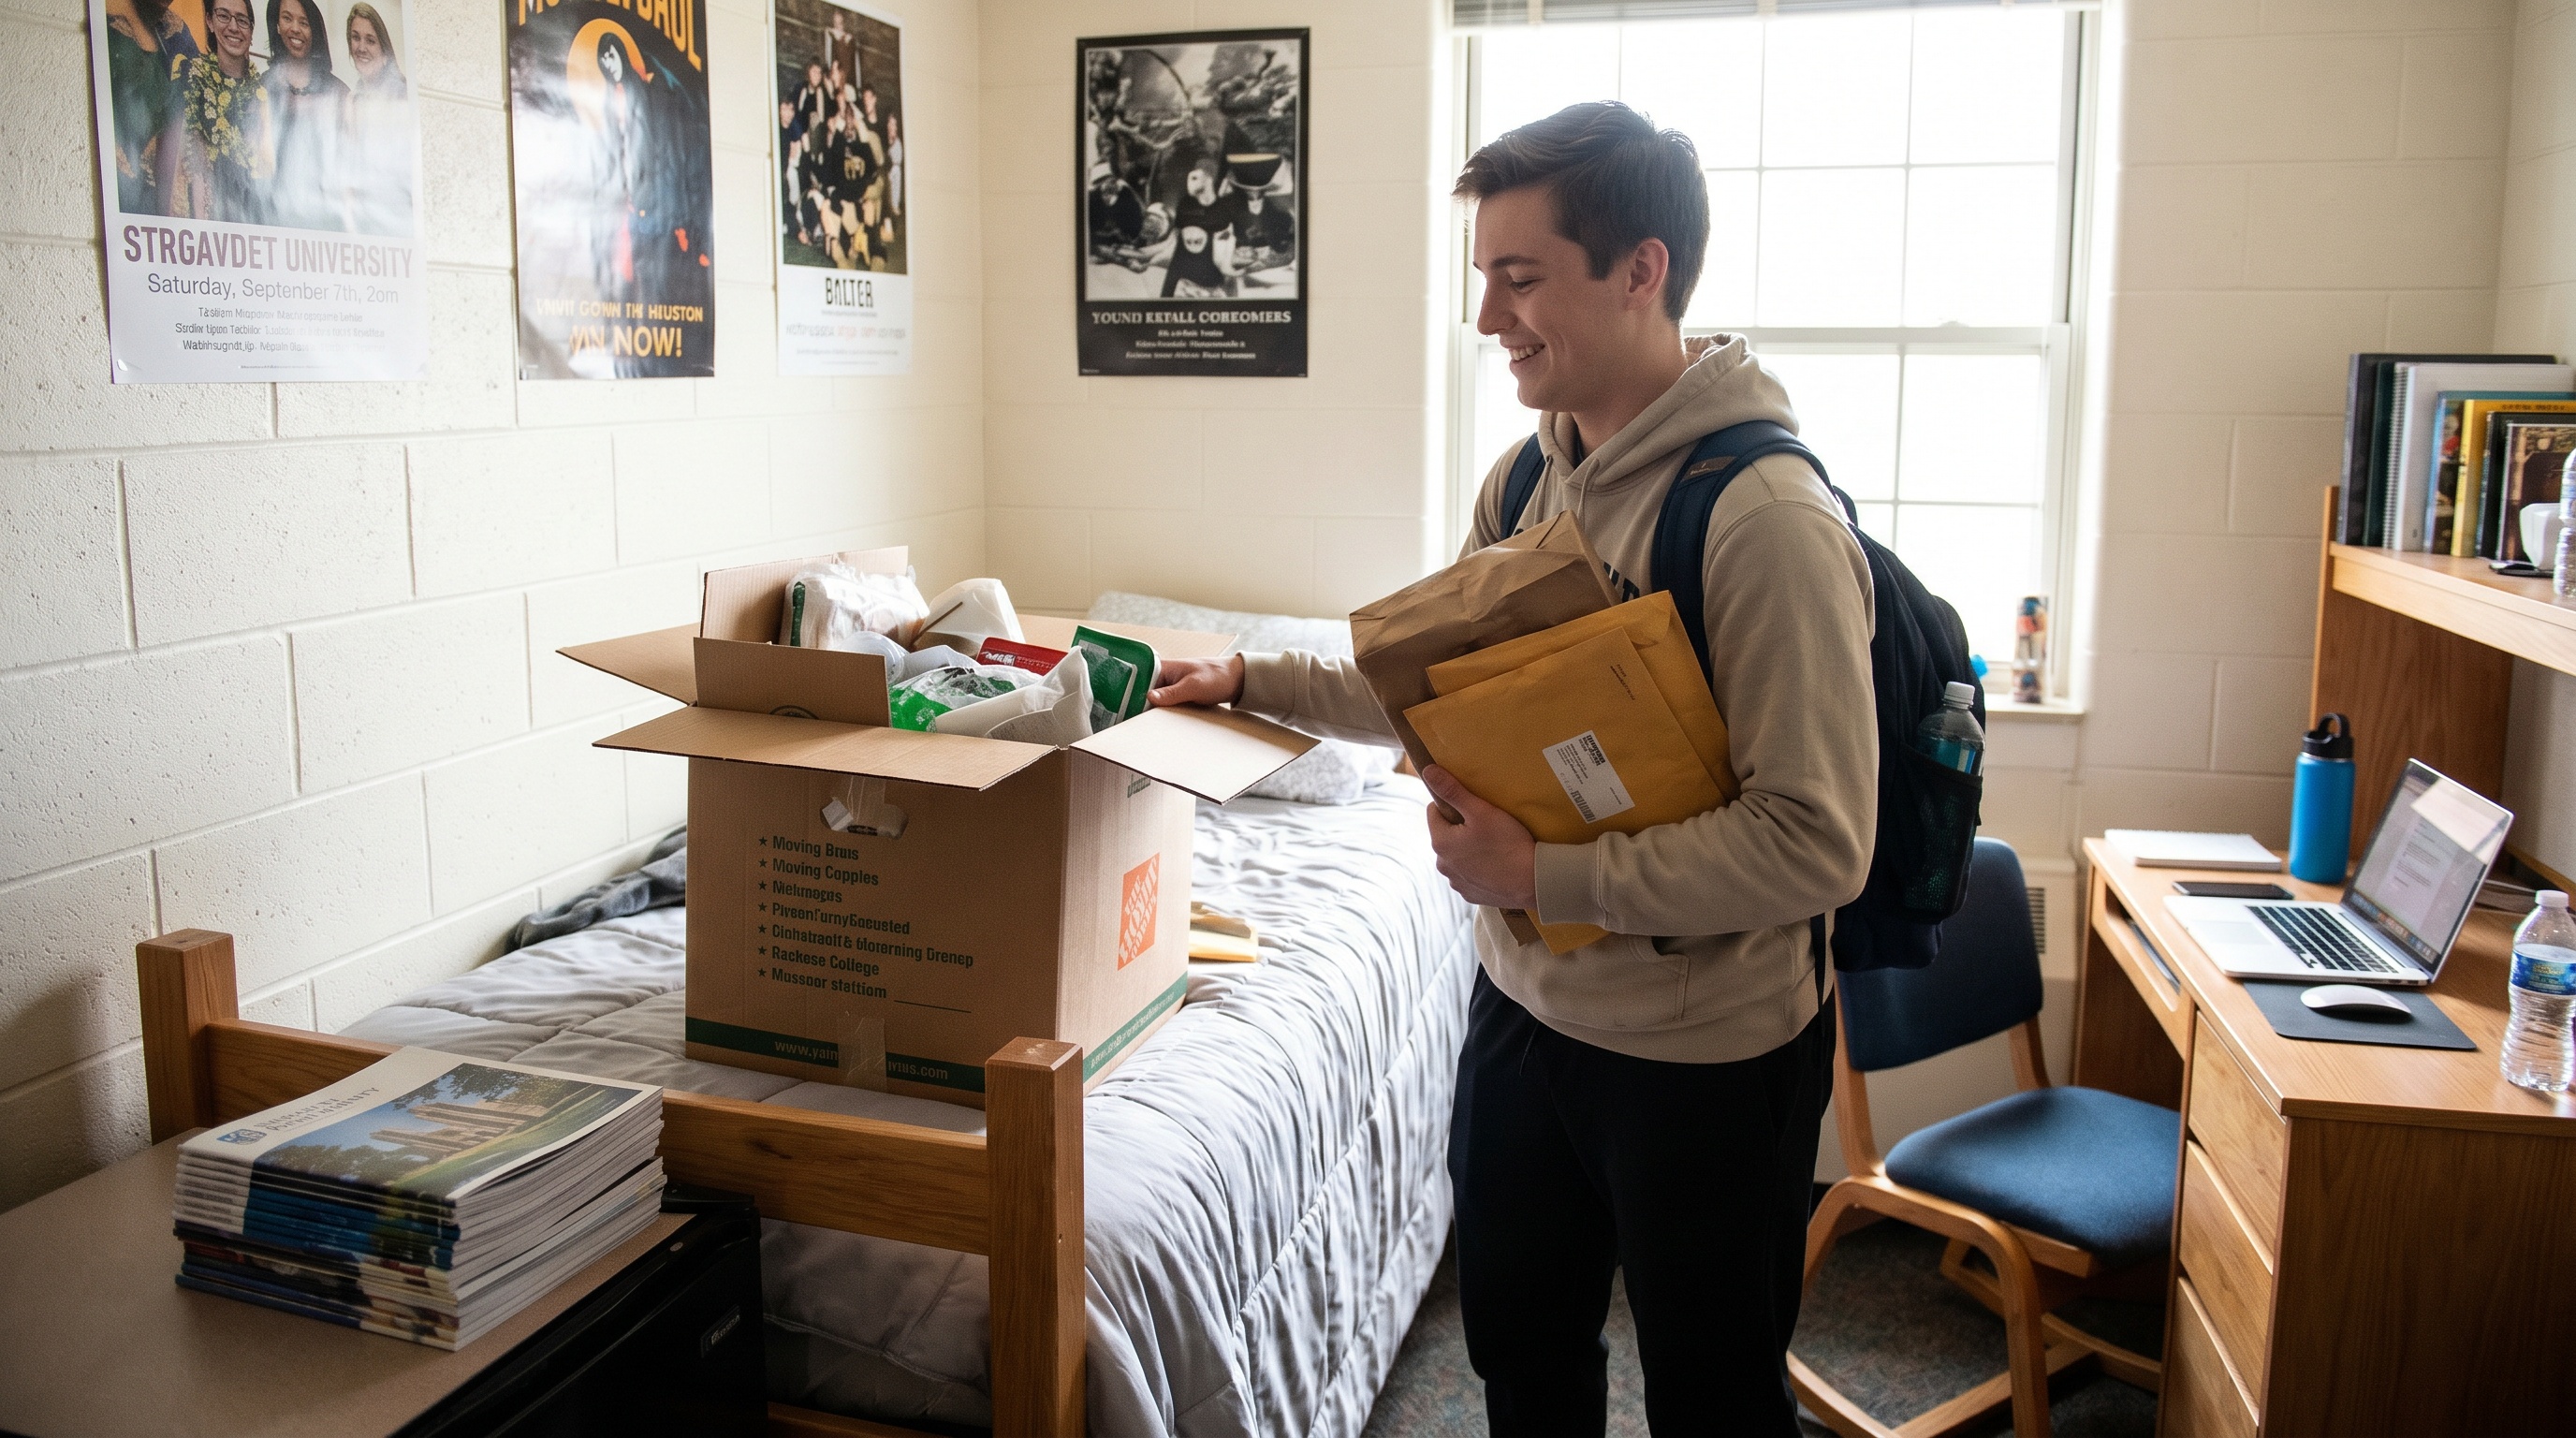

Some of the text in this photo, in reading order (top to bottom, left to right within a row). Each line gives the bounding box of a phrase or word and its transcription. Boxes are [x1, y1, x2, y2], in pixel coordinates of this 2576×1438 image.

[123, 225, 413, 279] STRGAVDET UNIVERSITY
[147, 272, 237, 301] Saturday,
[333, 284, 362, 303] 7th,
[613, 326, 682, 358] NOW!
[772, 835, 821, 858] Moving
[772, 858, 821, 880] Moving
